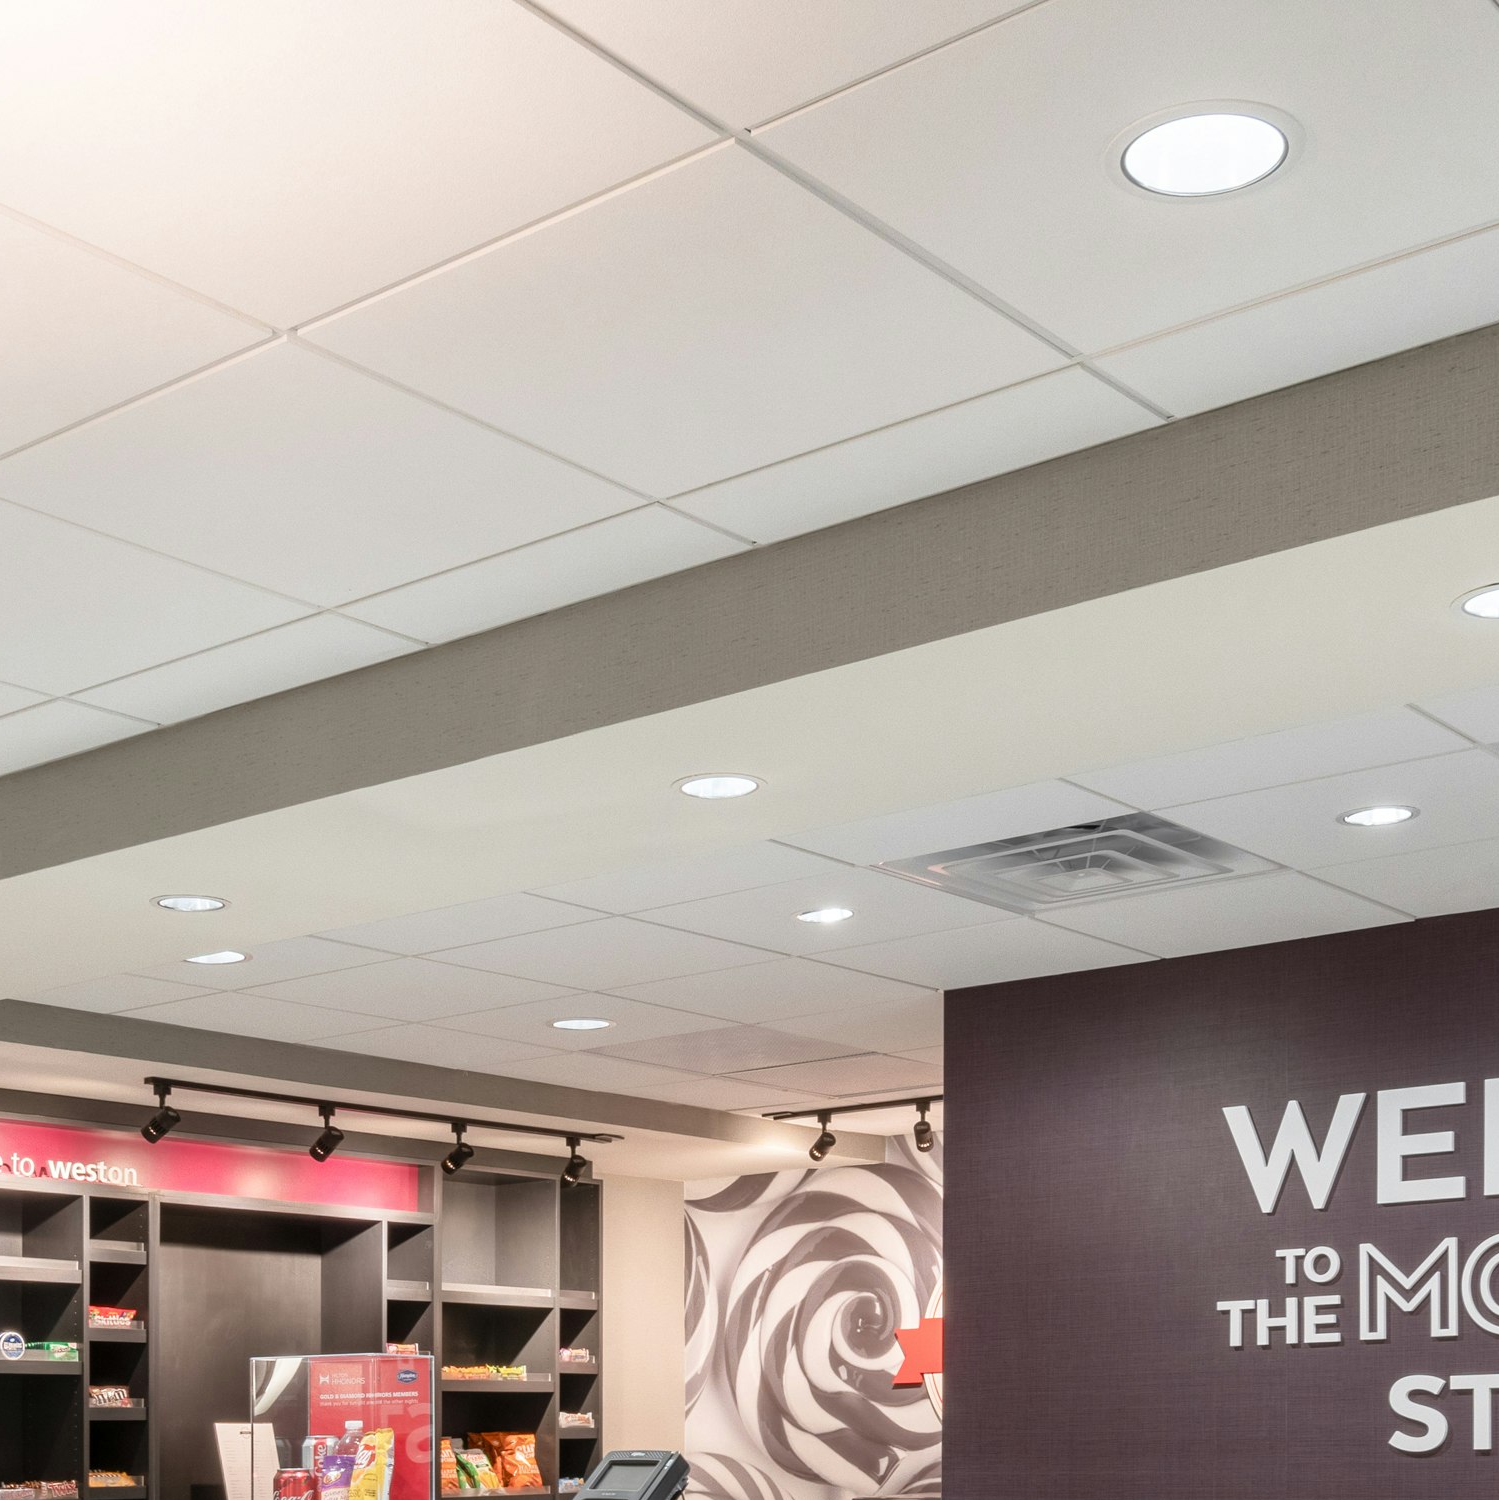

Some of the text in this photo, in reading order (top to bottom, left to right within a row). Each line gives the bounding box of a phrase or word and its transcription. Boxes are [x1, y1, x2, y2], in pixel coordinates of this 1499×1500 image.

[11, 1153, 35, 1177] to
[48, 1158, 138, 1185] weston
[1275, 1245, 1342, 1285] TO
[1217, 1293, 1343, 1348] THE
